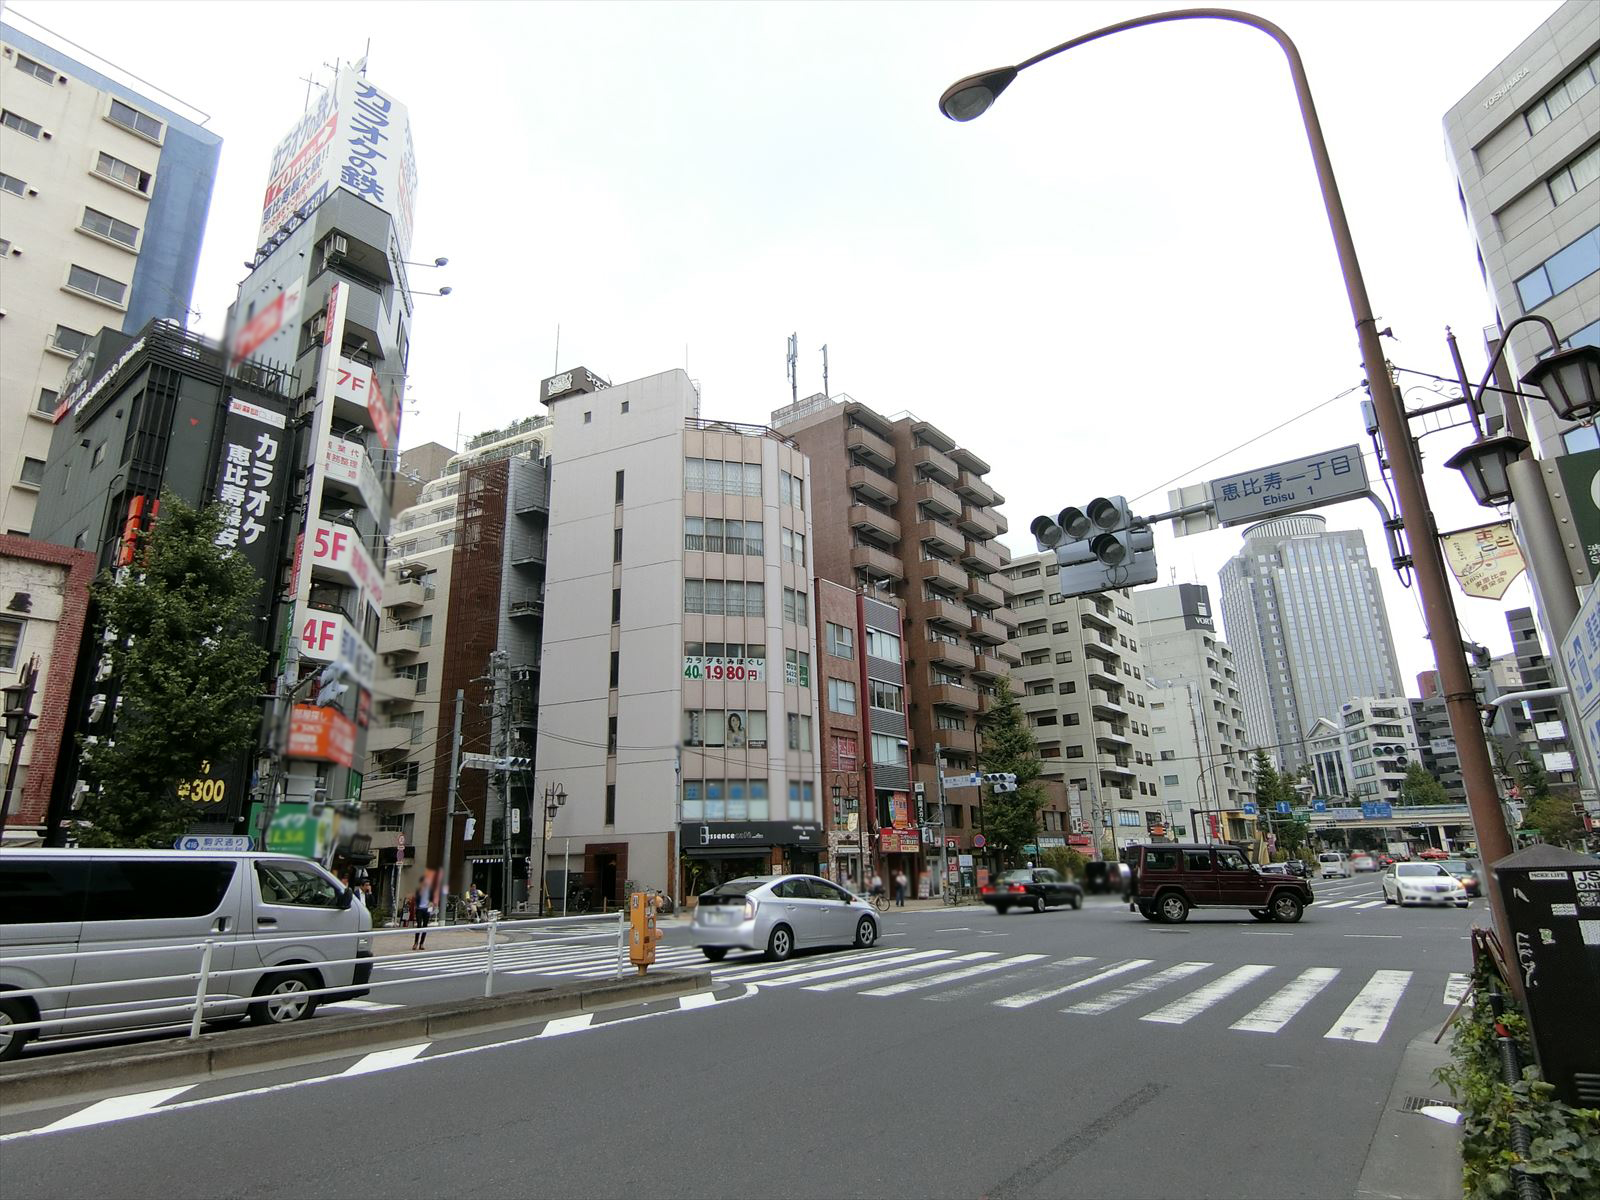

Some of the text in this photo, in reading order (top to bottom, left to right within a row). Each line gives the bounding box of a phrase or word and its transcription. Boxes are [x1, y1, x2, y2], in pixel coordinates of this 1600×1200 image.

[1484, 67, 1529, 109] YOSHIHARA
[341, 80, 392, 203] カラオケの鉄
[337, 368, 366, 392] 7F
[242, 433, 279, 545] カラオケ
[1221, 455, 1351, 503] 恵比寿一丁目
[1262, 486, 1314, 507] Ebisu 1
[313, 528, 348, 562] 5F
[302, 618, 336, 651] 4F
[686, 657, 763, 666] カラダもみほぐし
[204, 837, 243, 847] 駒沢通り
